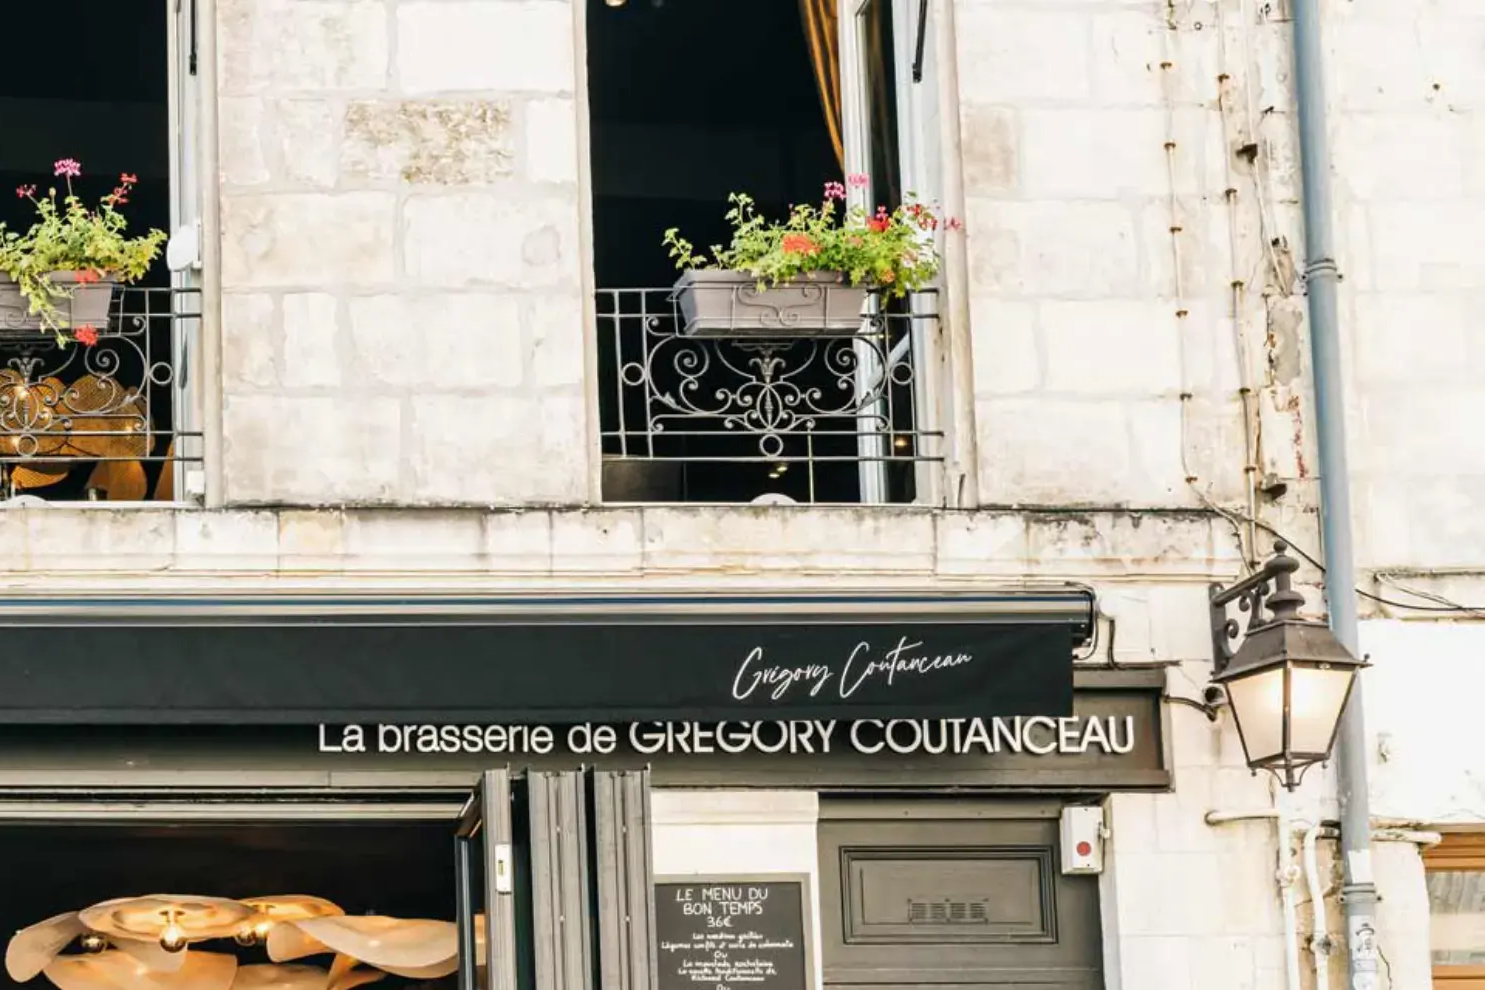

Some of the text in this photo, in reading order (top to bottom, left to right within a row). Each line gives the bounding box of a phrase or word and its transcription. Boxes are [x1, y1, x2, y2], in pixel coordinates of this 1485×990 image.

[732, 648, 833, 701] Grégory
[319, 723, 365, 754] La
[377, 717, 555, 755] brasserie
[568, 718, 618, 755] de
[849, 714, 1136, 756] COUTANCEAU
[676, 887, 769, 902] LE MENU DU
[683, 901, 764, 915] BON TEMPS
[706, 916, 733, 928] 36€
